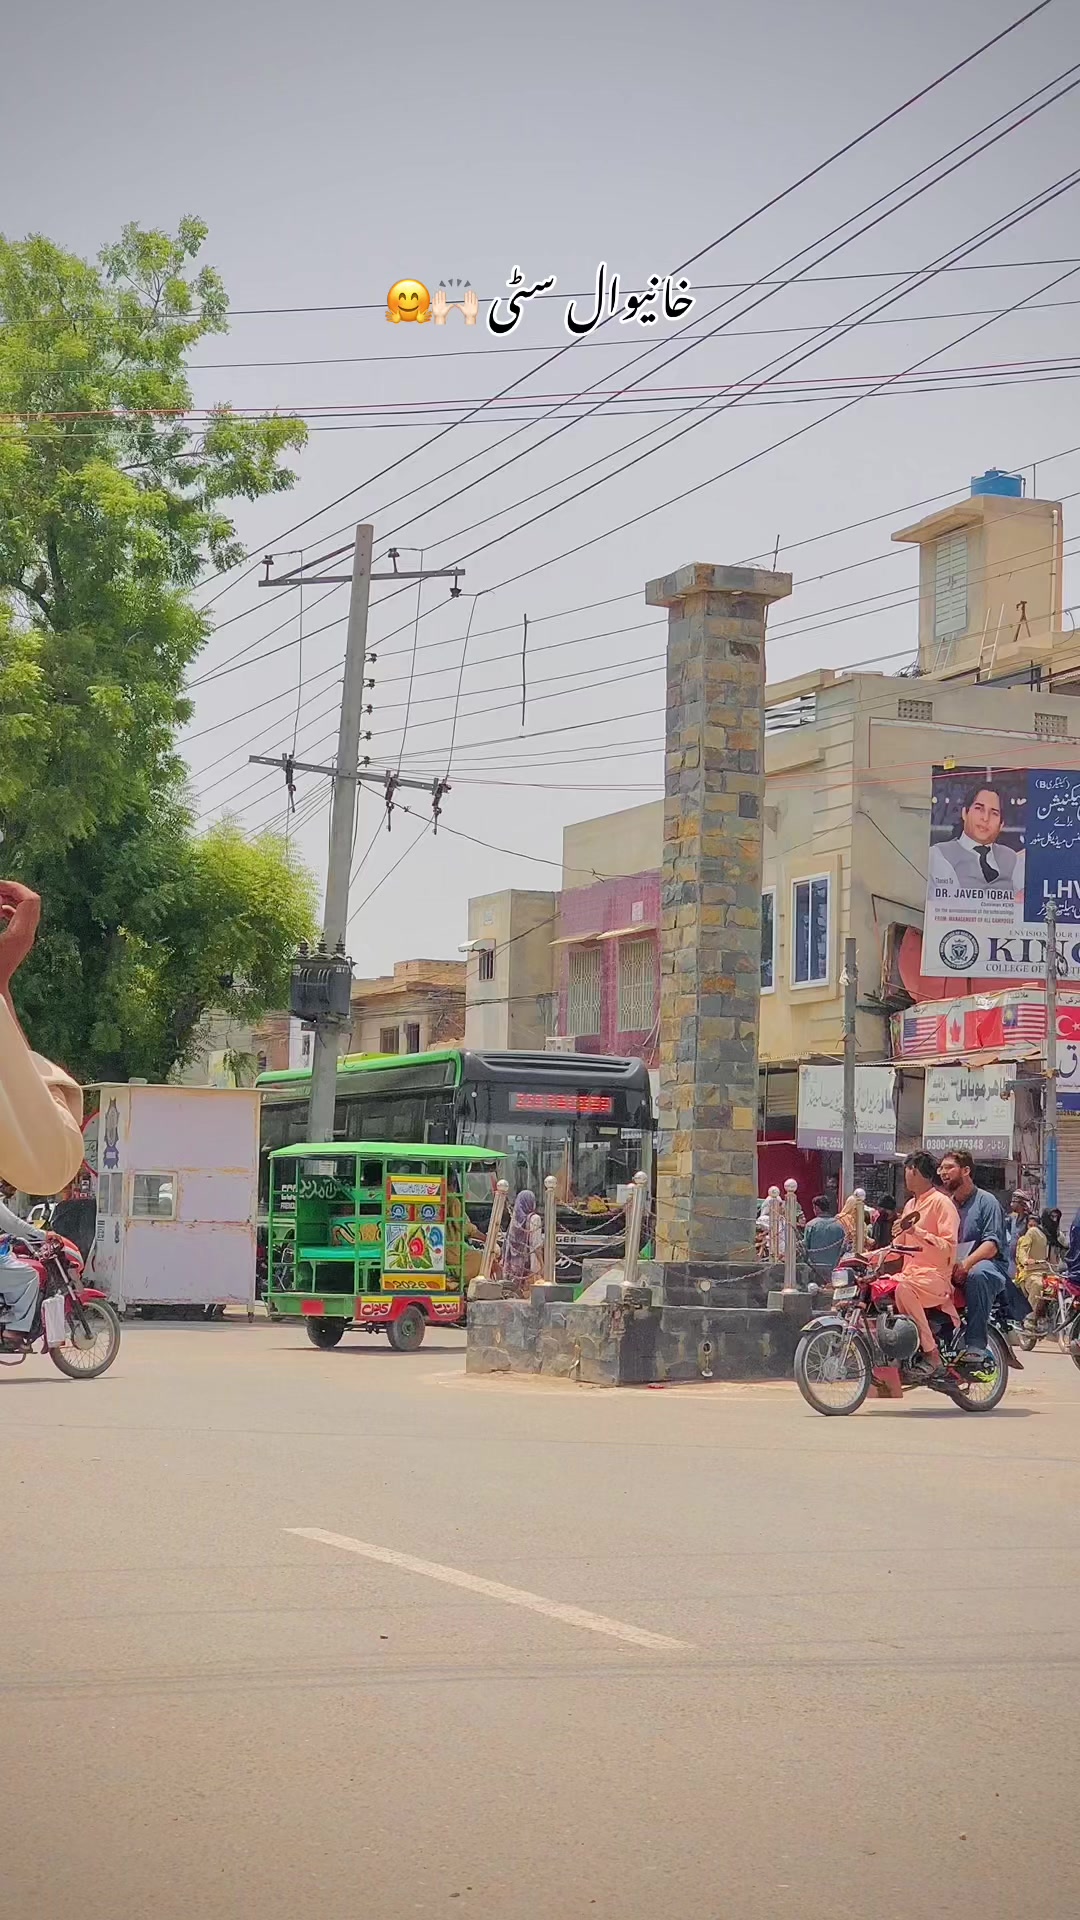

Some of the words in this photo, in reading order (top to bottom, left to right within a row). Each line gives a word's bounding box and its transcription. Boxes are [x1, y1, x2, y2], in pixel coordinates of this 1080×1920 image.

[935, 888, 951, 898] DR.
[954, 889, 984, 899] JAVED
[987, 890, 1015, 900] IQBAL
[986, 963, 1029, 973] COLLEGE
[1031, 964, 1043, 973] OF
[392, 1280, 427, 1289] 2026
